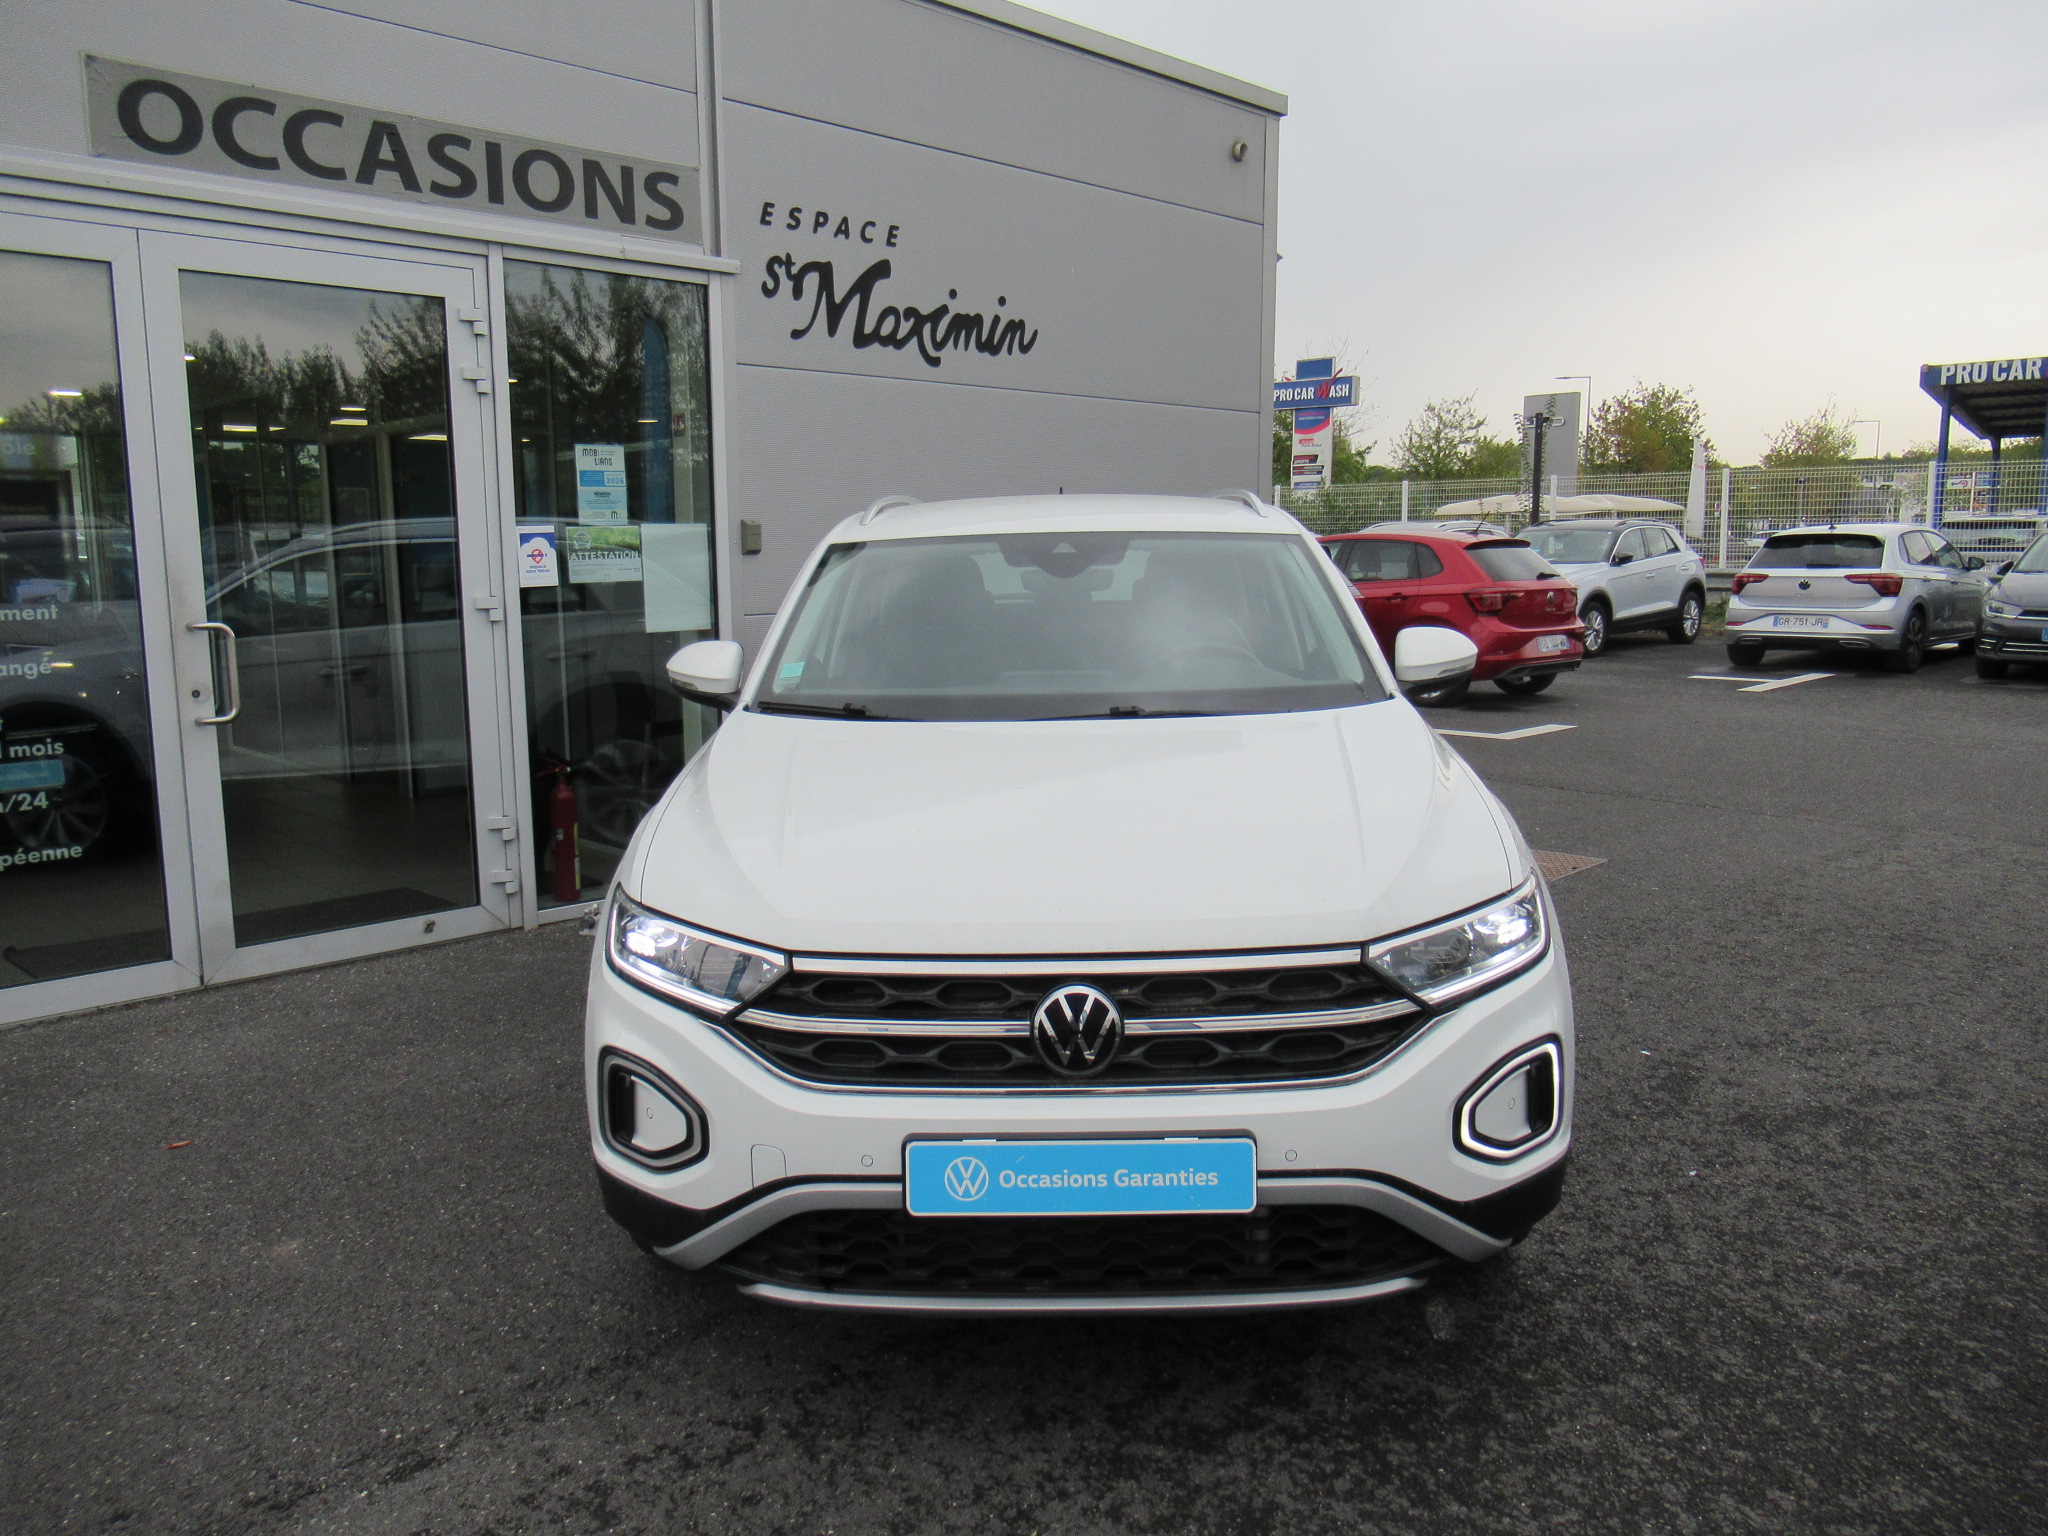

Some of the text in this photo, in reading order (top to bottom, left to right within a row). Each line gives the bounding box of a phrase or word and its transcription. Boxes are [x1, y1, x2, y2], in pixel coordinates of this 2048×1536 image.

[117, 78, 686, 232] OCCASIONS
[759, 200, 900, 248] ESPACE
[790, 258, 1039, 368] Maximin
[1941, 358, 2043, 386] PRO CAR
[1274, 378, 1350, 402] PRO CAR WASH
[570, 550, 640, 561] ATTESTATION
[0, 604, 58, 621] ment
[9, 738, 65, 758] mois
[999, 1168, 1108, 1188] Occasions
[1114, 1167, 1219, 1187] Garanties
